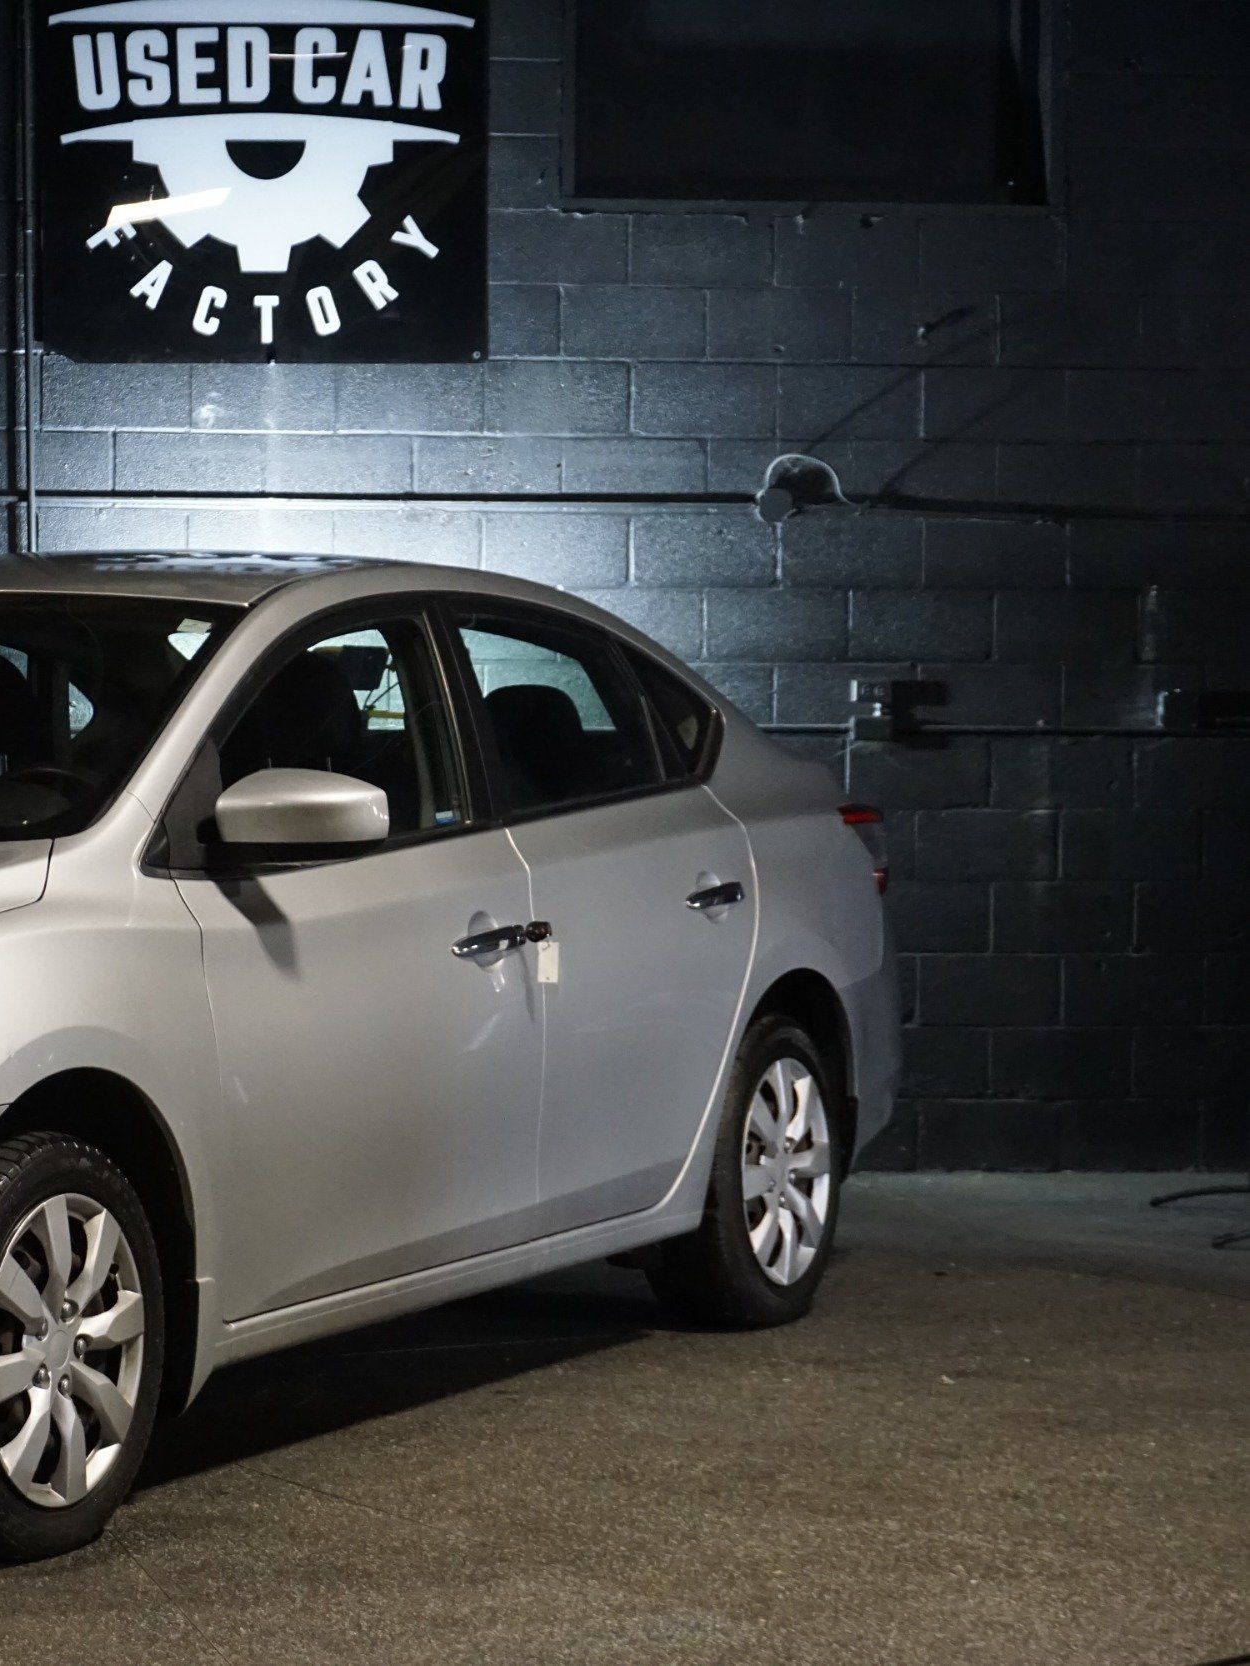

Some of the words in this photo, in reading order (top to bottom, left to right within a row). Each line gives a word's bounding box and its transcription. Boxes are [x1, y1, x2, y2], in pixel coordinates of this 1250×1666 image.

[72, 27, 271, 111] USED
[293, 27, 448, 111] CAR
[85, 214, 440, 345] FACTORY
